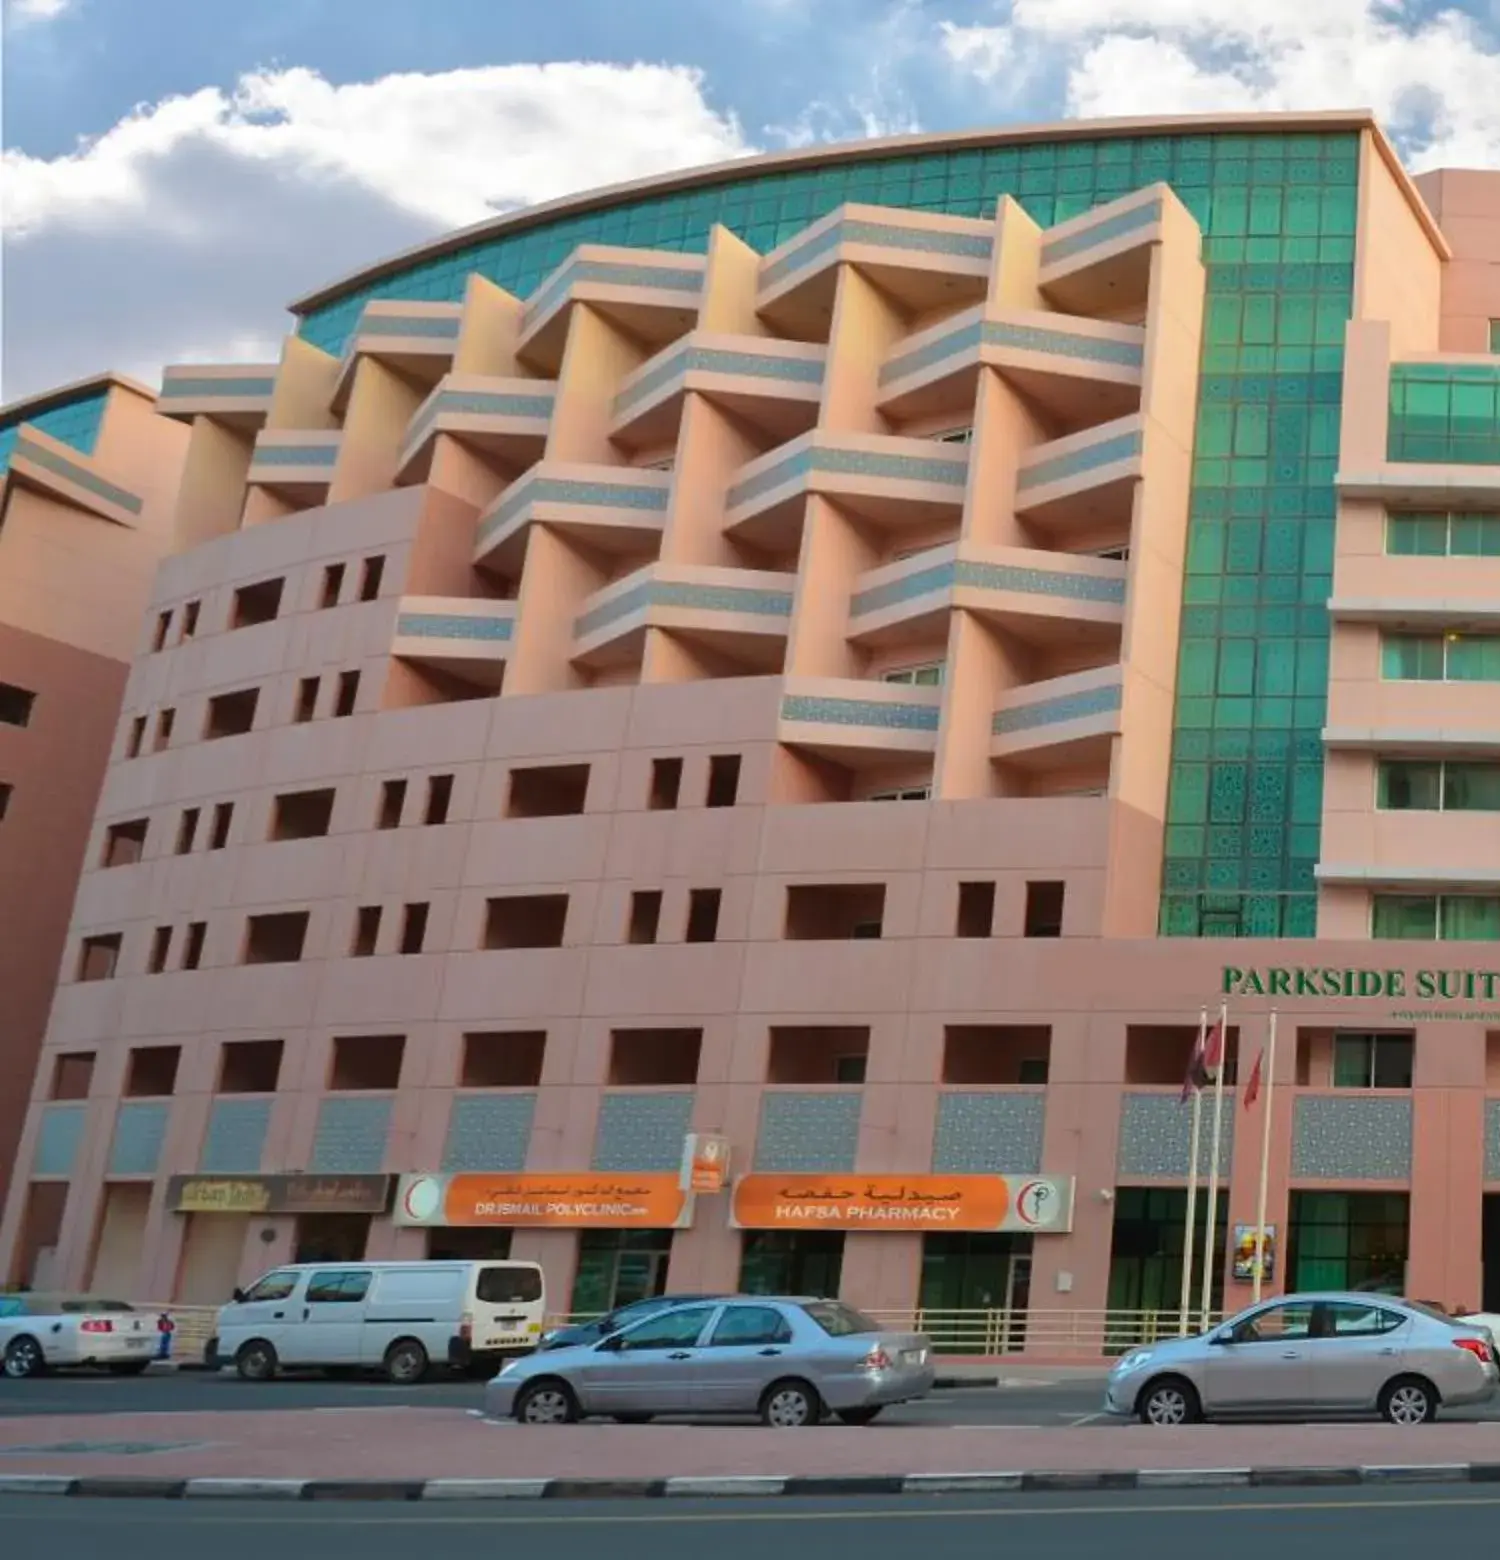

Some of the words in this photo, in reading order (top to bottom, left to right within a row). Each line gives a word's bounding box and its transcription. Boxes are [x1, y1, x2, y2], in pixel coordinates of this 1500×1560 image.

[1220, 966, 1406, 998] PARKSIDE
[863, 1183, 962, 1206] صيدلية
[545, 1203, 633, 1216] POLYCLINIC
[775, 1205, 842, 1220] HAFSA
[846, 1205, 961, 1221] PHARMACY
